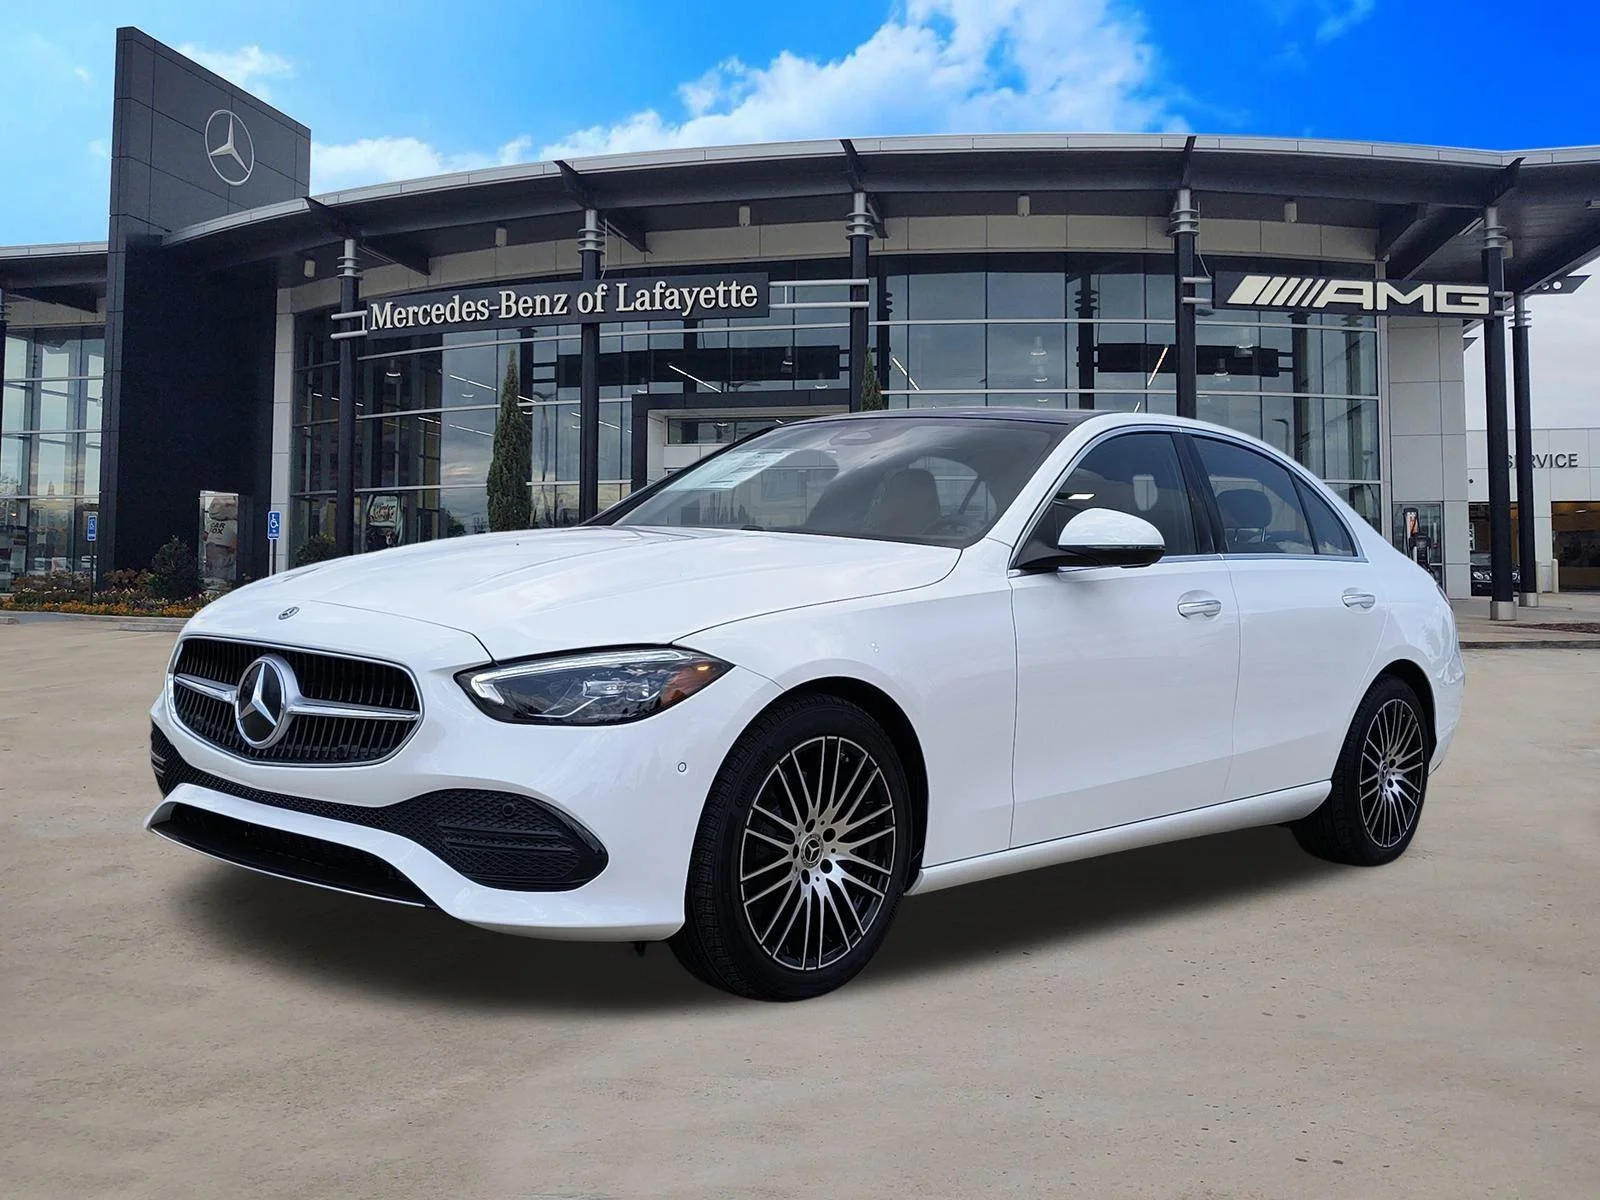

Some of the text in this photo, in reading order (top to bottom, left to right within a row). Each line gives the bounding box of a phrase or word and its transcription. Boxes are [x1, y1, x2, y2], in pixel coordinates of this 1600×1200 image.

[370, 280, 758, 330] Mercedes-Benz of Lafayette
[1312, 279, 1489, 315] AMG
[1505, 453, 1578, 468] SRVICE
